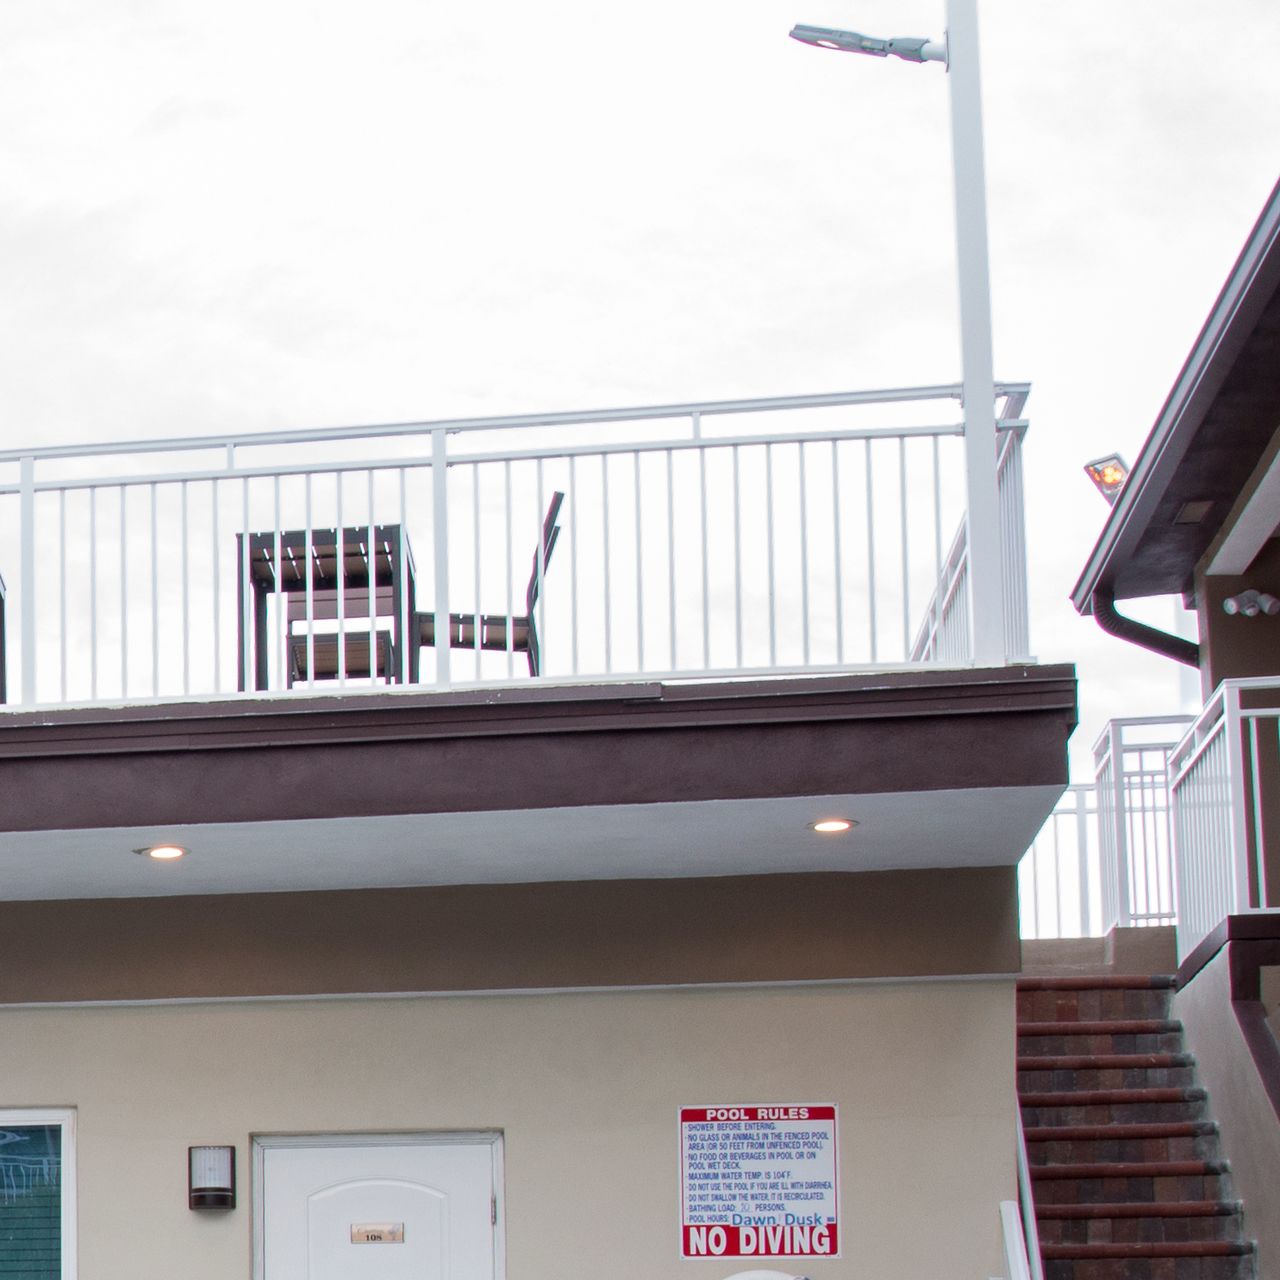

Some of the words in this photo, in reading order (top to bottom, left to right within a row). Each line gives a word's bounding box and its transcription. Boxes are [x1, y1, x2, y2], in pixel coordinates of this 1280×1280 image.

[706, 1109, 749, 1120] POOL
[757, 1108, 809, 1119] RULES
[717, 1123, 742, 1131] BEFORE
[688, 1134, 697, 1142] NO
[721, 1133, 730, 1141] OR
[762, 1132, 769, 1140] IN
[771, 1132, 783, 1140] THE
[784, 1132, 810, 1140] FENCED
[812, 1132, 829, 1140] POOL
[719, 1142, 728, 1150] 50
[729, 1142, 744, 1150] FEET
[747, 1142, 765, 1150] FROM
[766, 1141, 800, 1149] UNFENCED
[688, 1153, 697, 1161] NO
[730, 1152, 766, 1160] BEVERAGES
[689, 1162, 705, 1170] POOL
[688, 1172, 719, 1180] MAXIMUM
[756, 1182, 768, 1190] YOU
[769, 1182, 779, 1190] ARE
[689, 1215, 705, 1223] POOL
[732, 1214, 776, 1225] Dawn
[785, 1213, 822, 1225] Dusk
[690, 1227, 727, 1256] NO
[740, 1226, 830, 1255] DIVING
